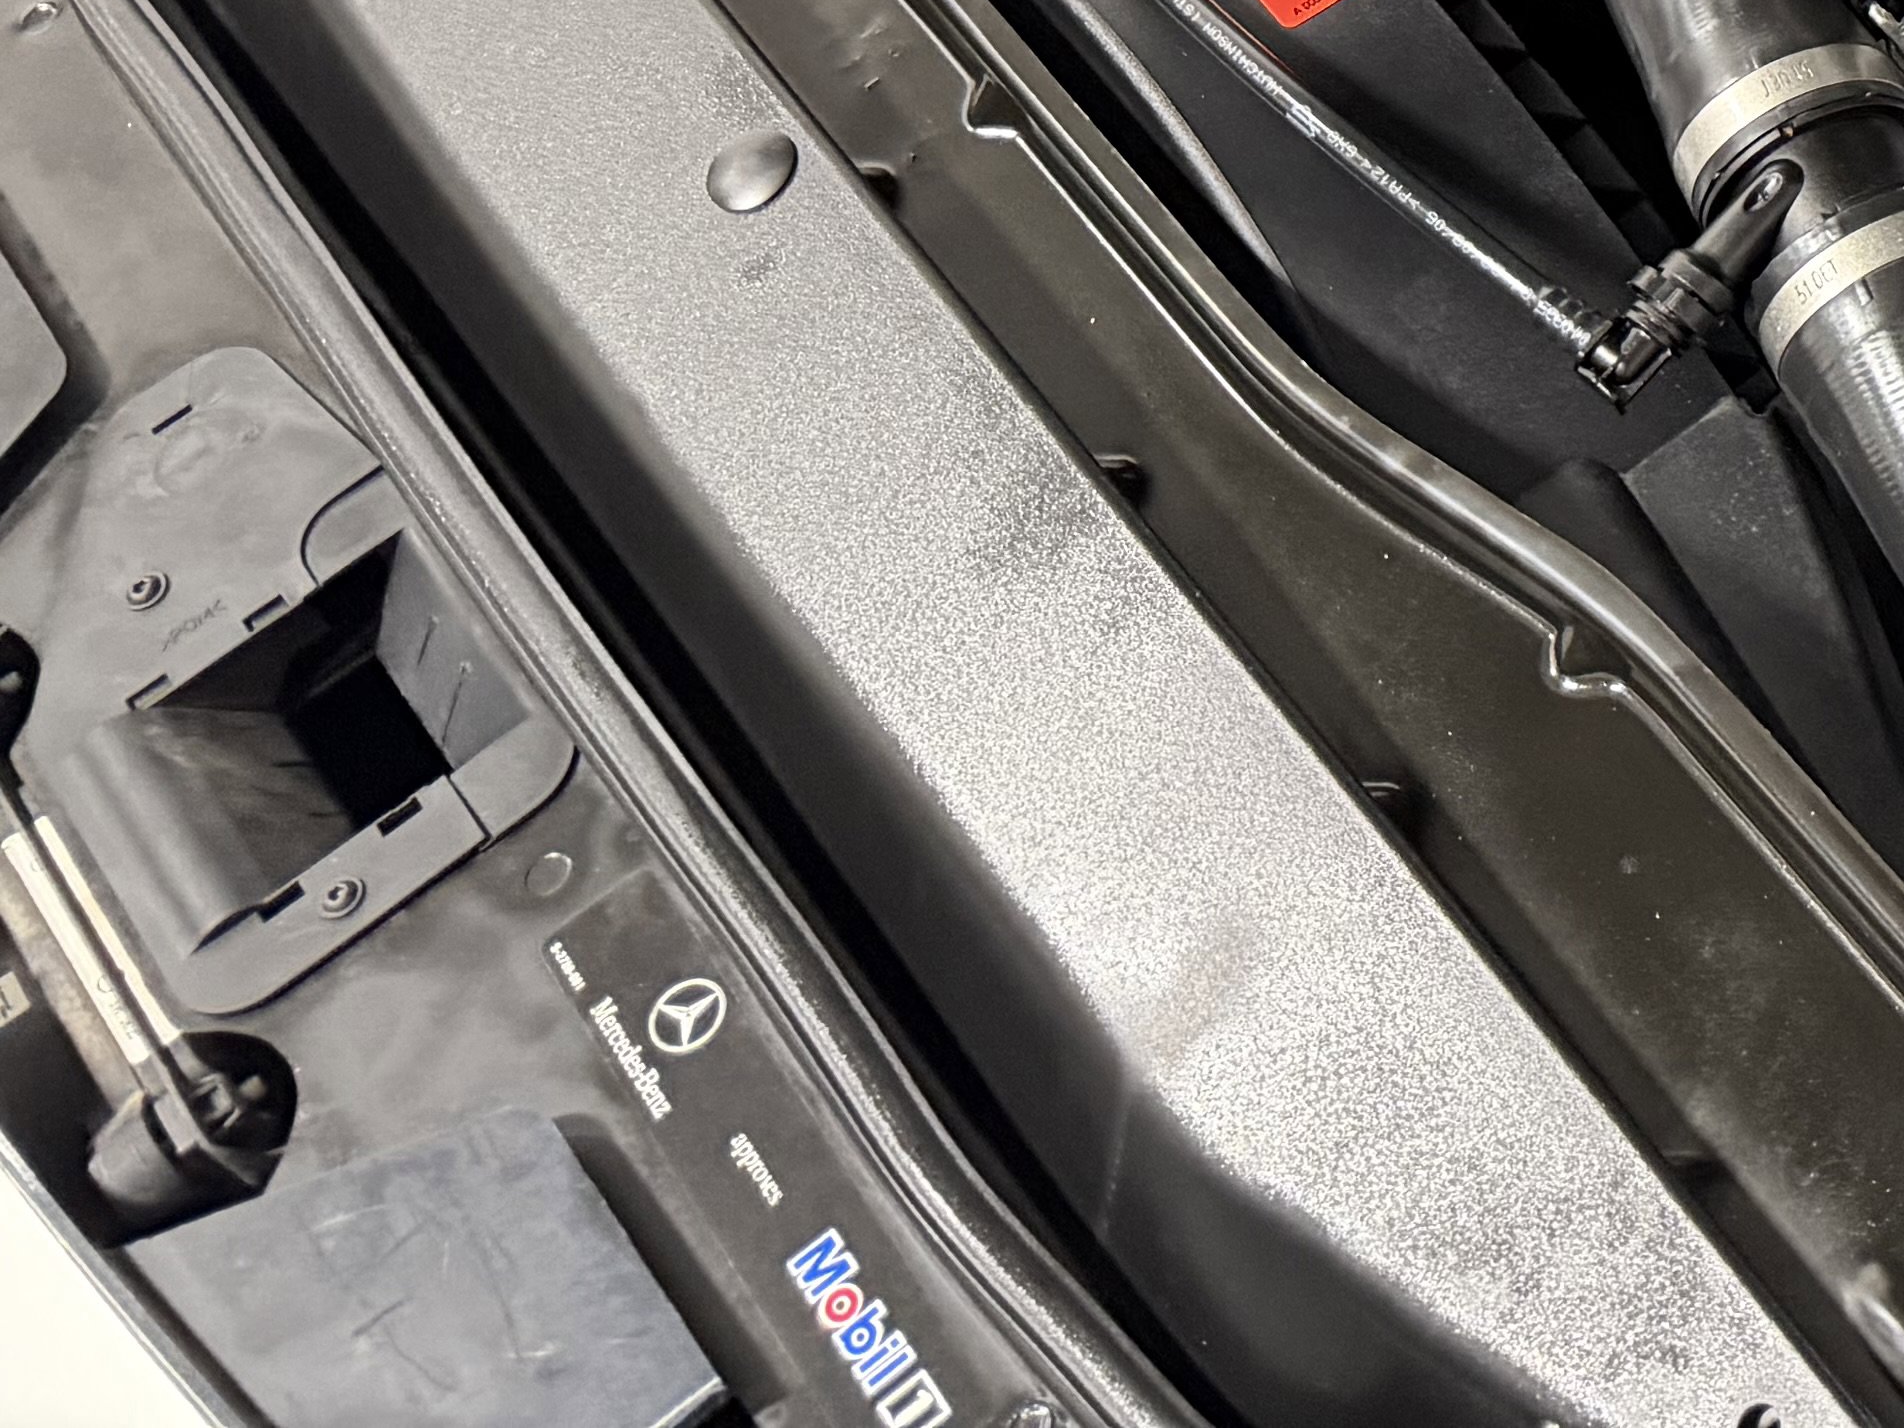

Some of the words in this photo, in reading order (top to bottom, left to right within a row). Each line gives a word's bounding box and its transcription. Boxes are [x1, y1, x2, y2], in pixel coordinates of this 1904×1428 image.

[1199, 19, 1284, 96] HUTCHINSON
[589, 995, 673, 1122] Mercedes-Benz
[730, 1131, 785, 1207] approves
[786, 1227, 917, 1403] Mobil
